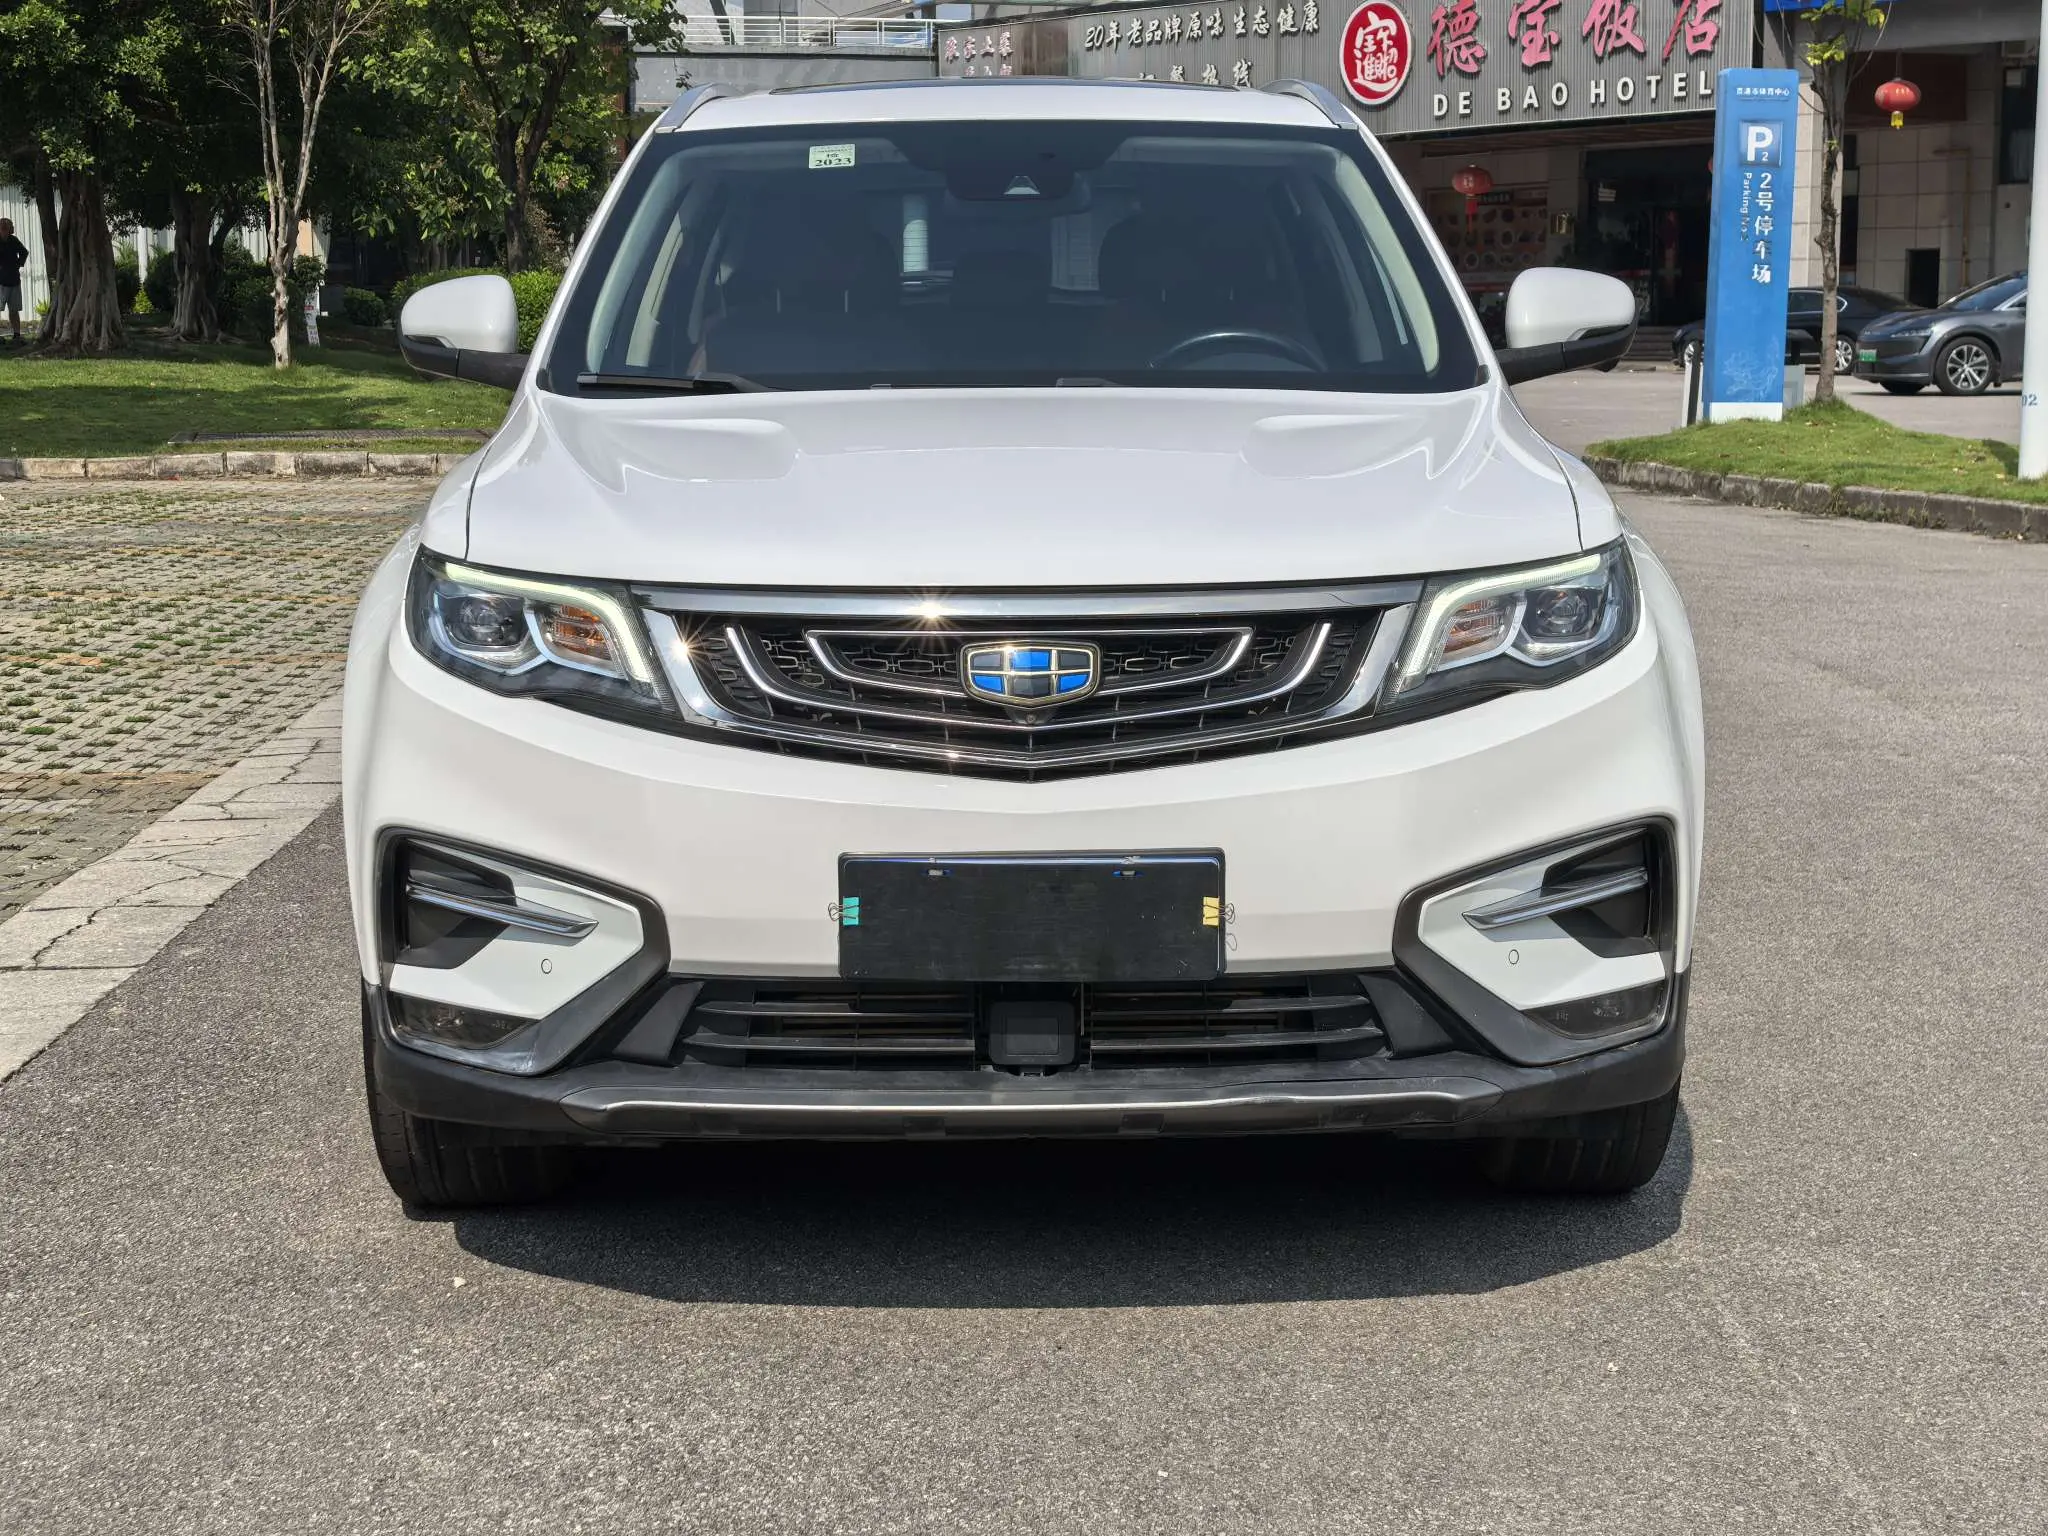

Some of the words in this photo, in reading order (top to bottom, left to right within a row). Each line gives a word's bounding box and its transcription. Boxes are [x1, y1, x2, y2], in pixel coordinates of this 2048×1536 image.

[1427, 0, 1721, 74] 德宝饭店
[1433, 92, 1471, 117] DE
[1497, 82, 1569, 112] BAO
[1590, 69, 1713, 105] HOTEL
[815, 157, 852, 167] 2023
[1746, 125, 1774, 162] P
[1739, 172, 1752, 214] Parking
[1752, 172, 1774, 284] 2号停车场
